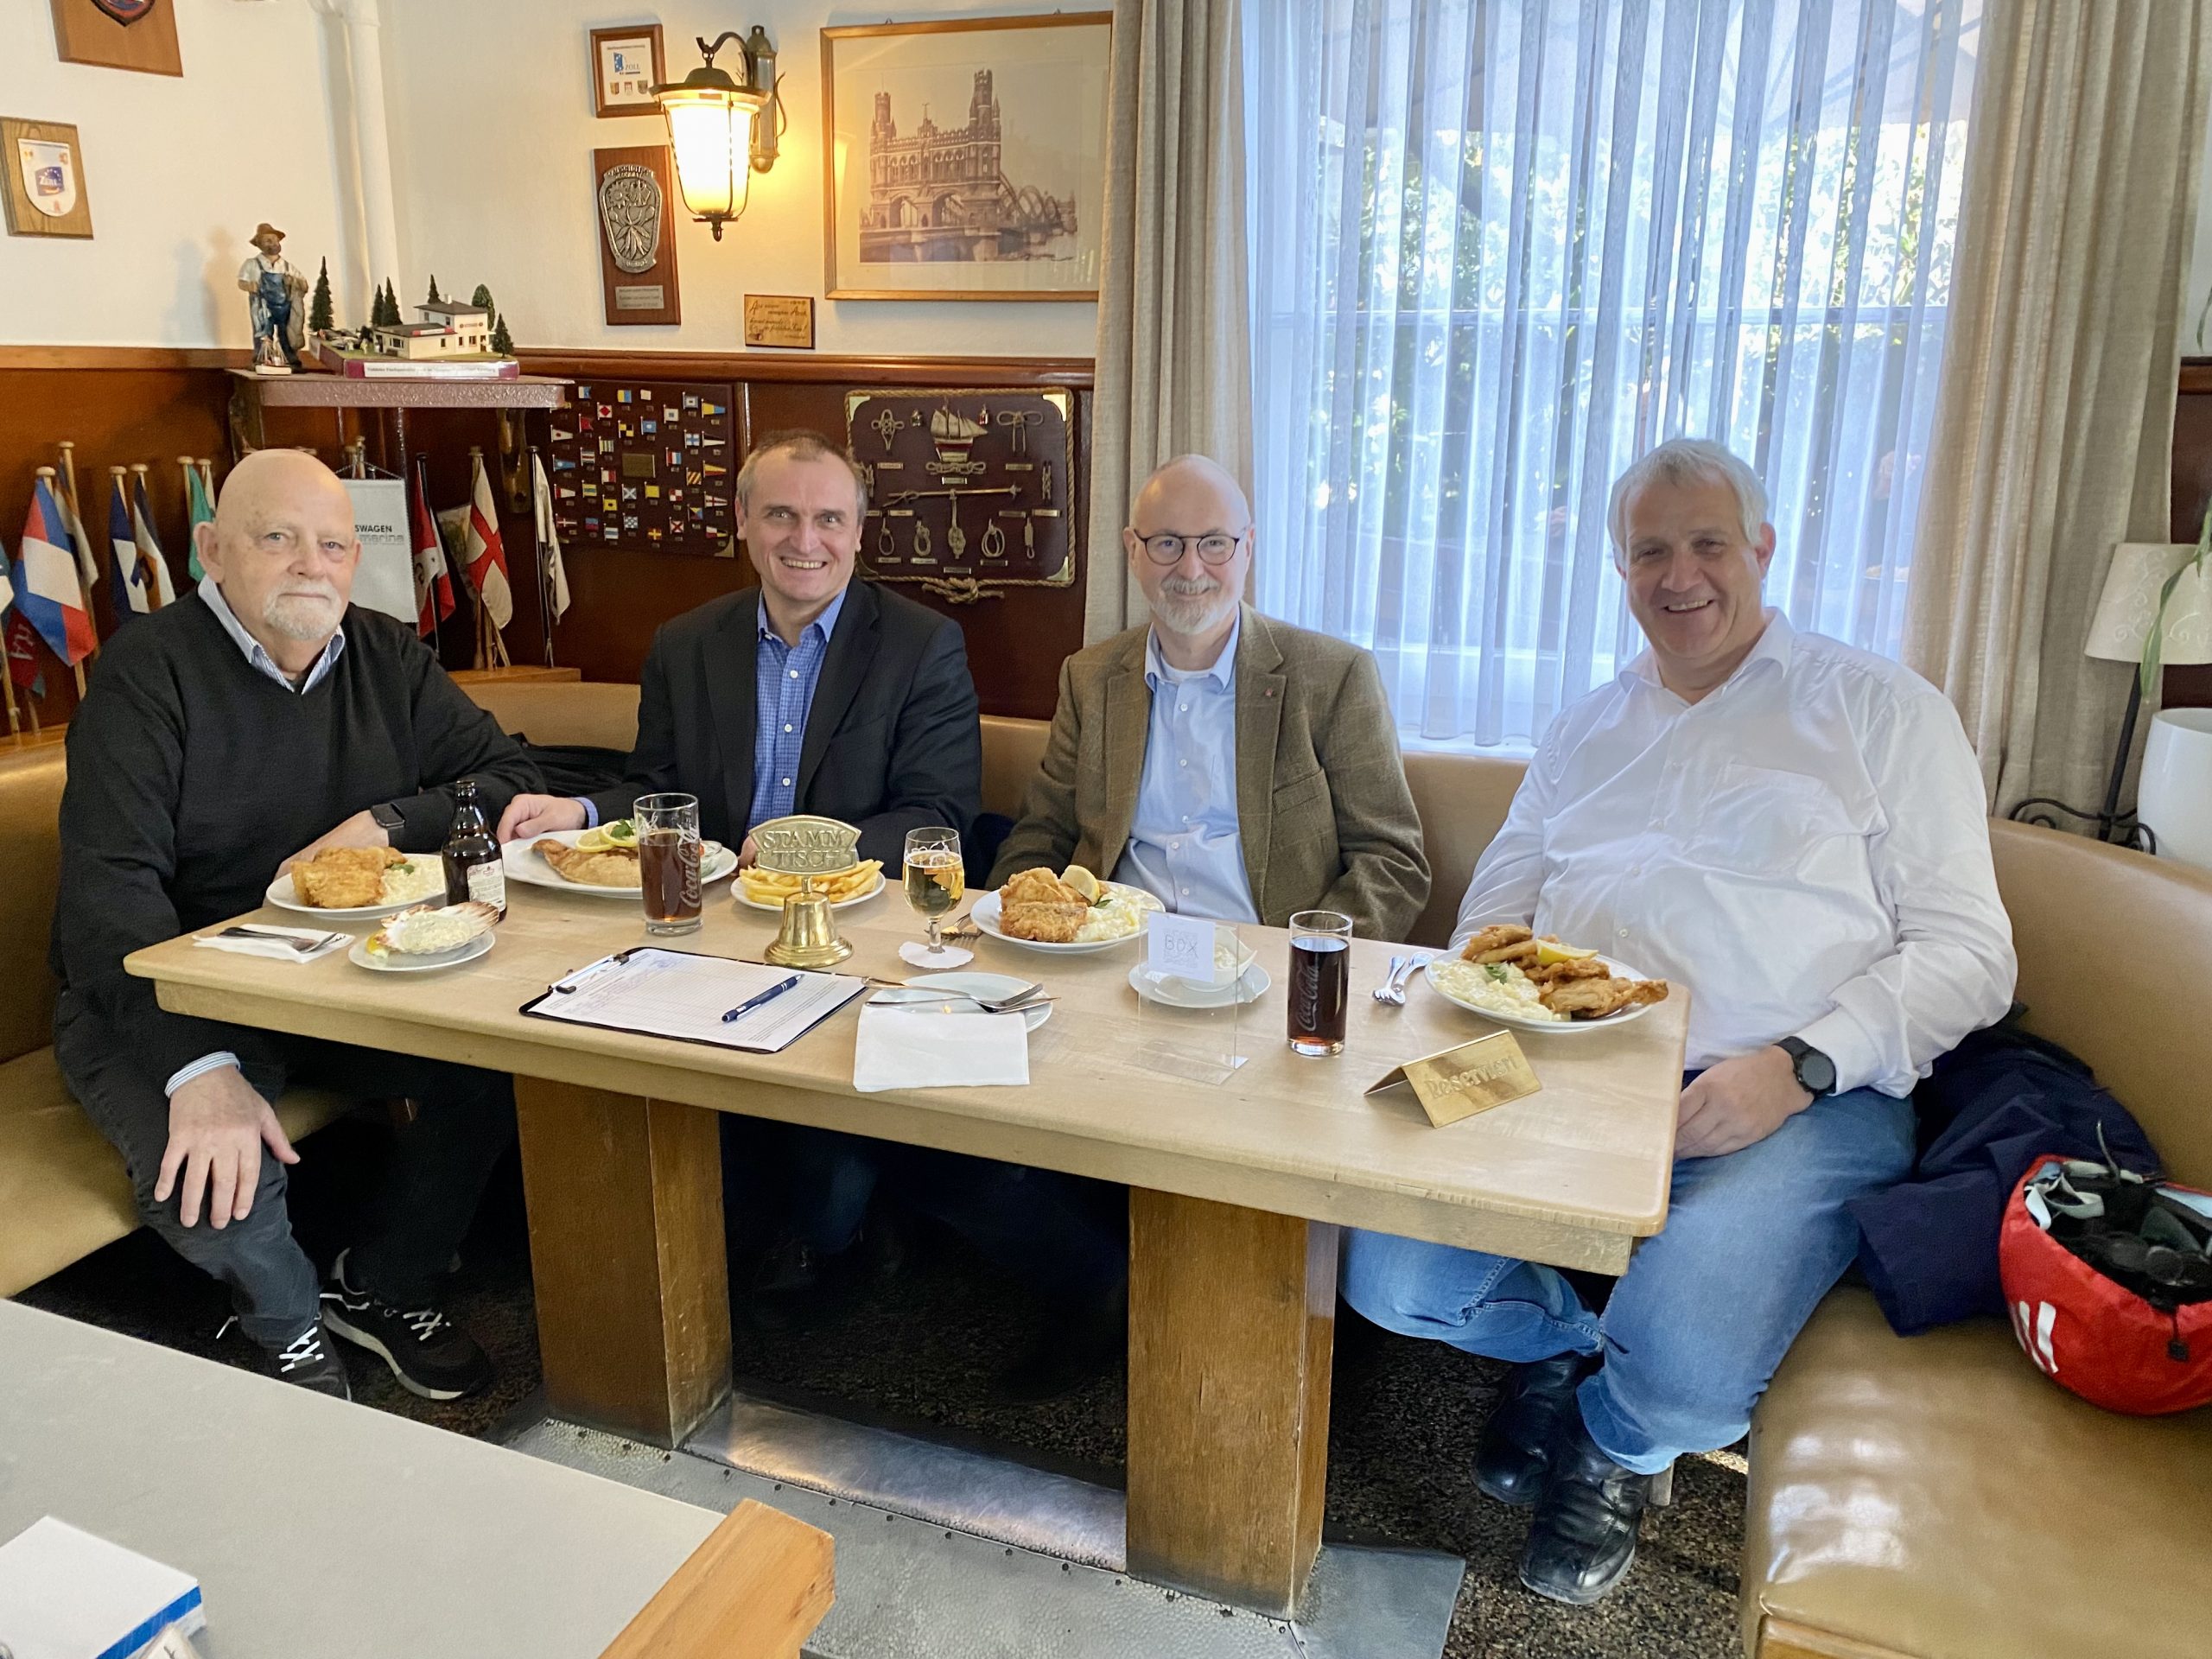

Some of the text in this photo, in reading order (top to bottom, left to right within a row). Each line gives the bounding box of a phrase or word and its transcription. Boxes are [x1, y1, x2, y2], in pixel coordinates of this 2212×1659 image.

[354, 524, 392, 533] SWAGEN
[763, 830, 846, 848] STAMM
[772, 850, 841, 868] TISCH
[1164, 934, 1199, 960] BOX
[1297, 954, 1319, 1032] Coca-Cola
[1426, 1055, 1518, 1099] Reserviert
